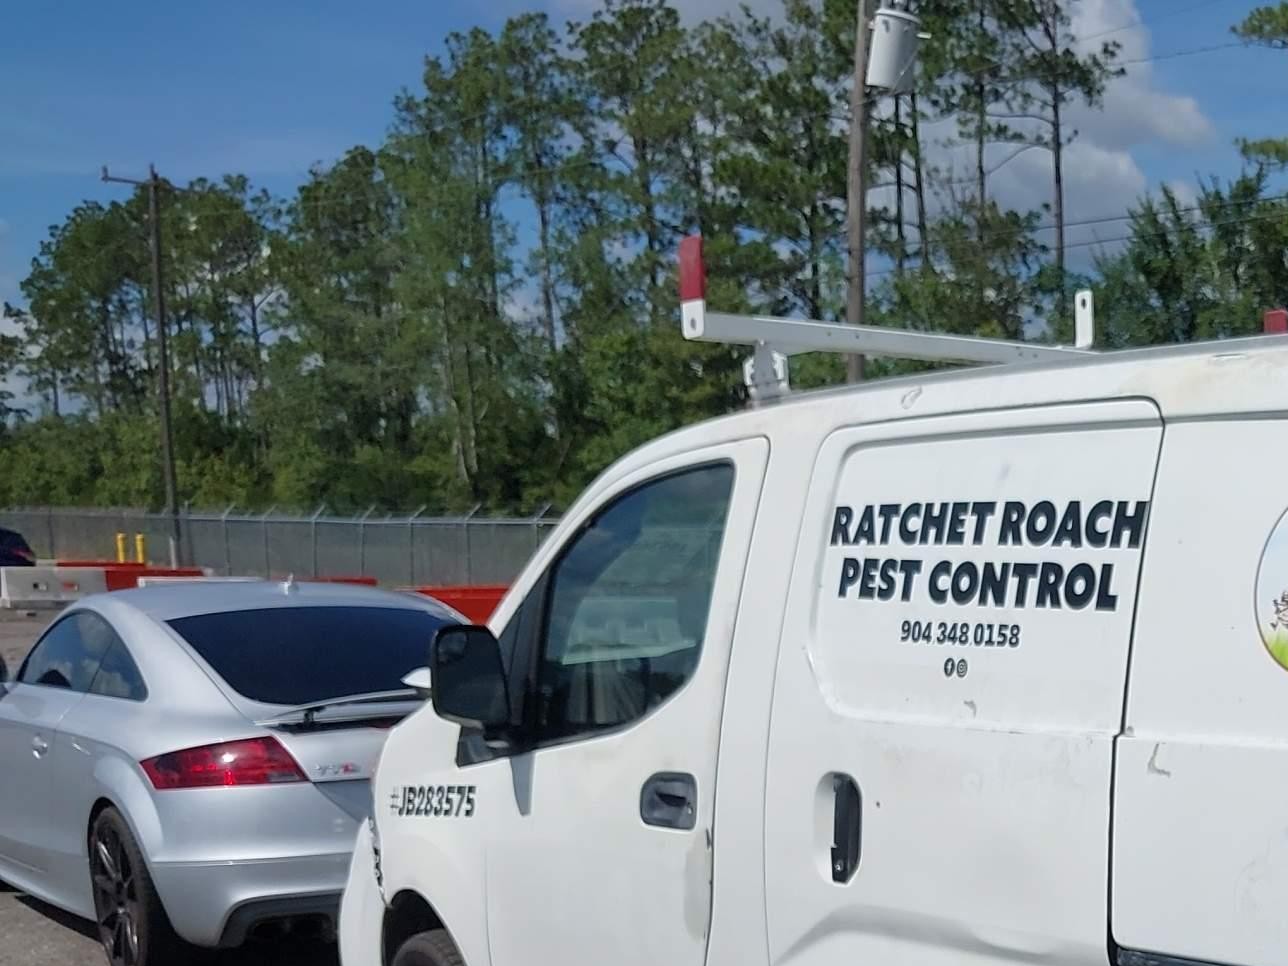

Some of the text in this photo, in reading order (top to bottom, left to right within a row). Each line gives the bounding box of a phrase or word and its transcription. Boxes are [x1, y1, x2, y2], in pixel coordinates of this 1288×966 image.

[830, 499, 1151, 549] RATCHET ROACH
[837, 557, 1119, 612] PEST CONTROL
